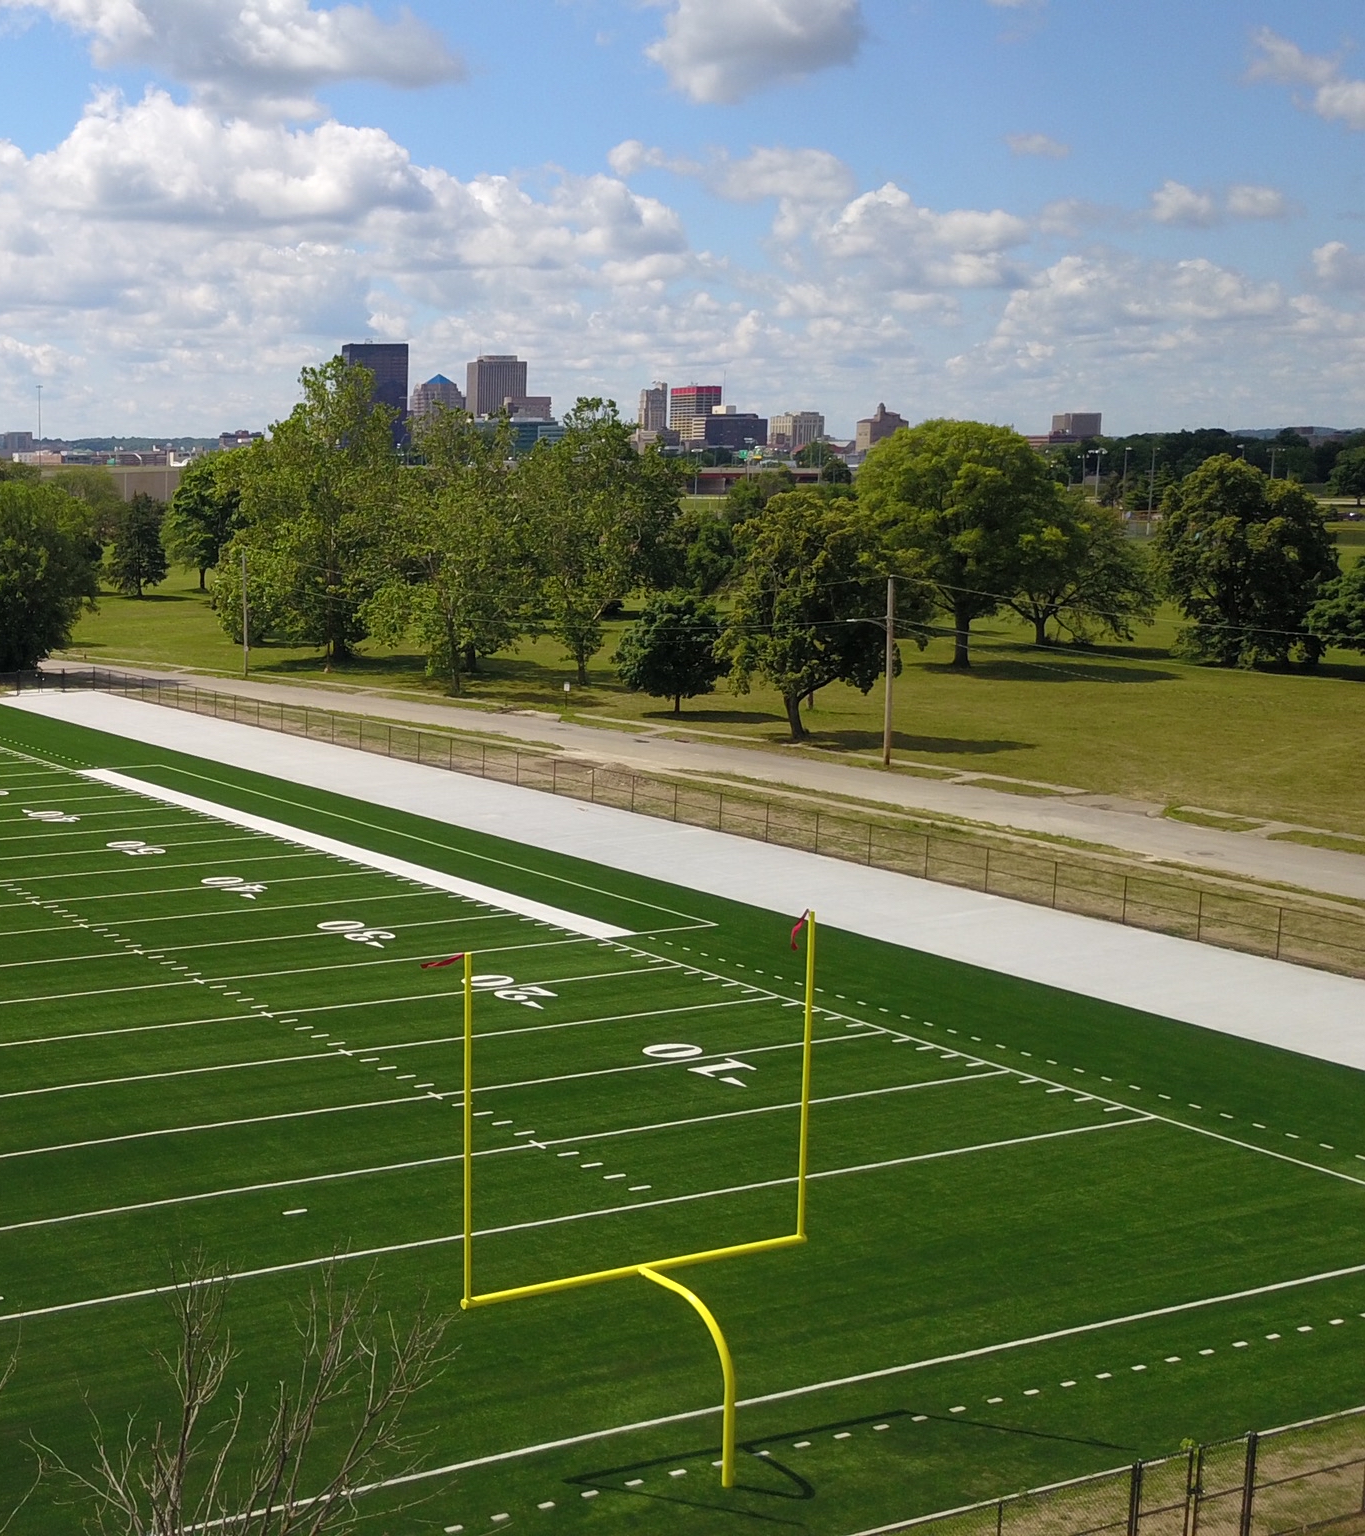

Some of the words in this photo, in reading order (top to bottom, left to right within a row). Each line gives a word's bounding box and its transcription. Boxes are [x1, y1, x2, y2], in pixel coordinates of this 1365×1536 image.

[28, 811, 81, 823] 40
[106, 841, 166, 856] 50
[201, 876, 268, 893] 40
[317, 921, 396, 942] 30
[461, 974, 558, 1001] 20
[642, 1043, 757, 1078] 10
